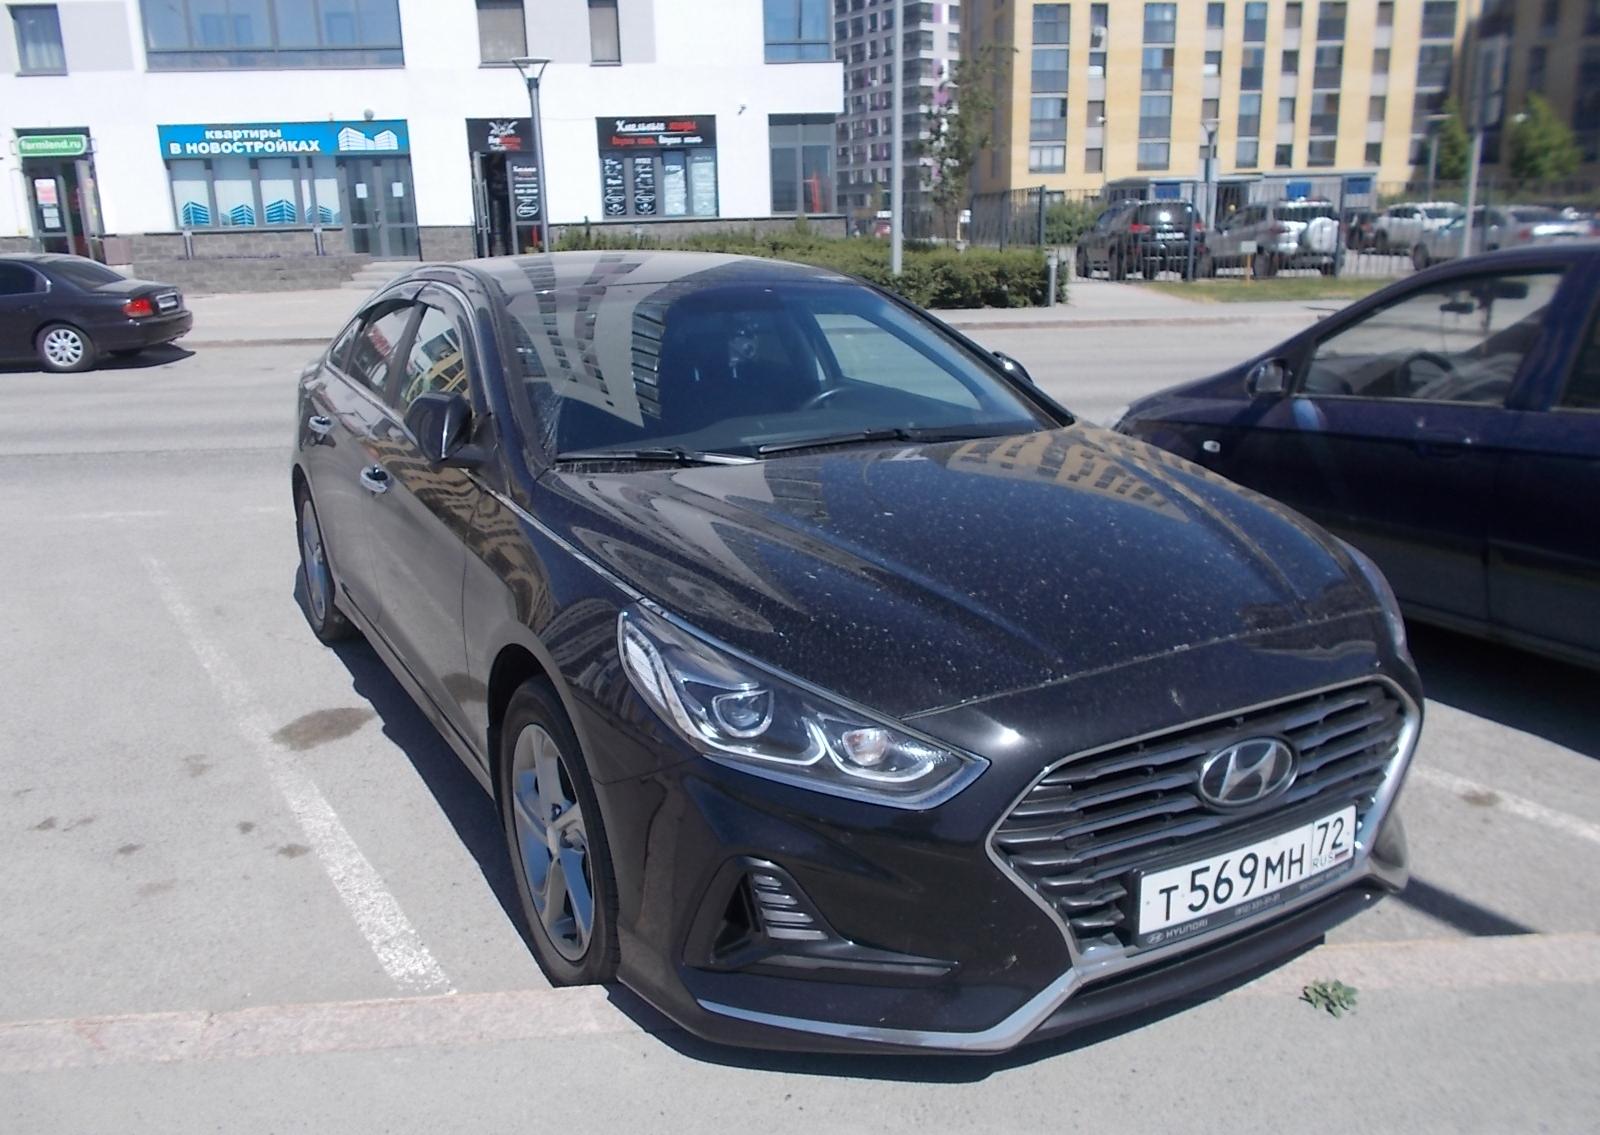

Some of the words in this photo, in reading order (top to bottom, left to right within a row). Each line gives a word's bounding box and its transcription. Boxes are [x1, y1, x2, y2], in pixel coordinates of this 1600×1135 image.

[204, 128, 282, 142] квартиры
[170, 143, 182, 155] В
[187, 138, 321, 155] НОВОСТРОЙКАХ
[1317, 816, 1345, 856] 72
[1165, 919, 1209, 939] HYUNDAI
